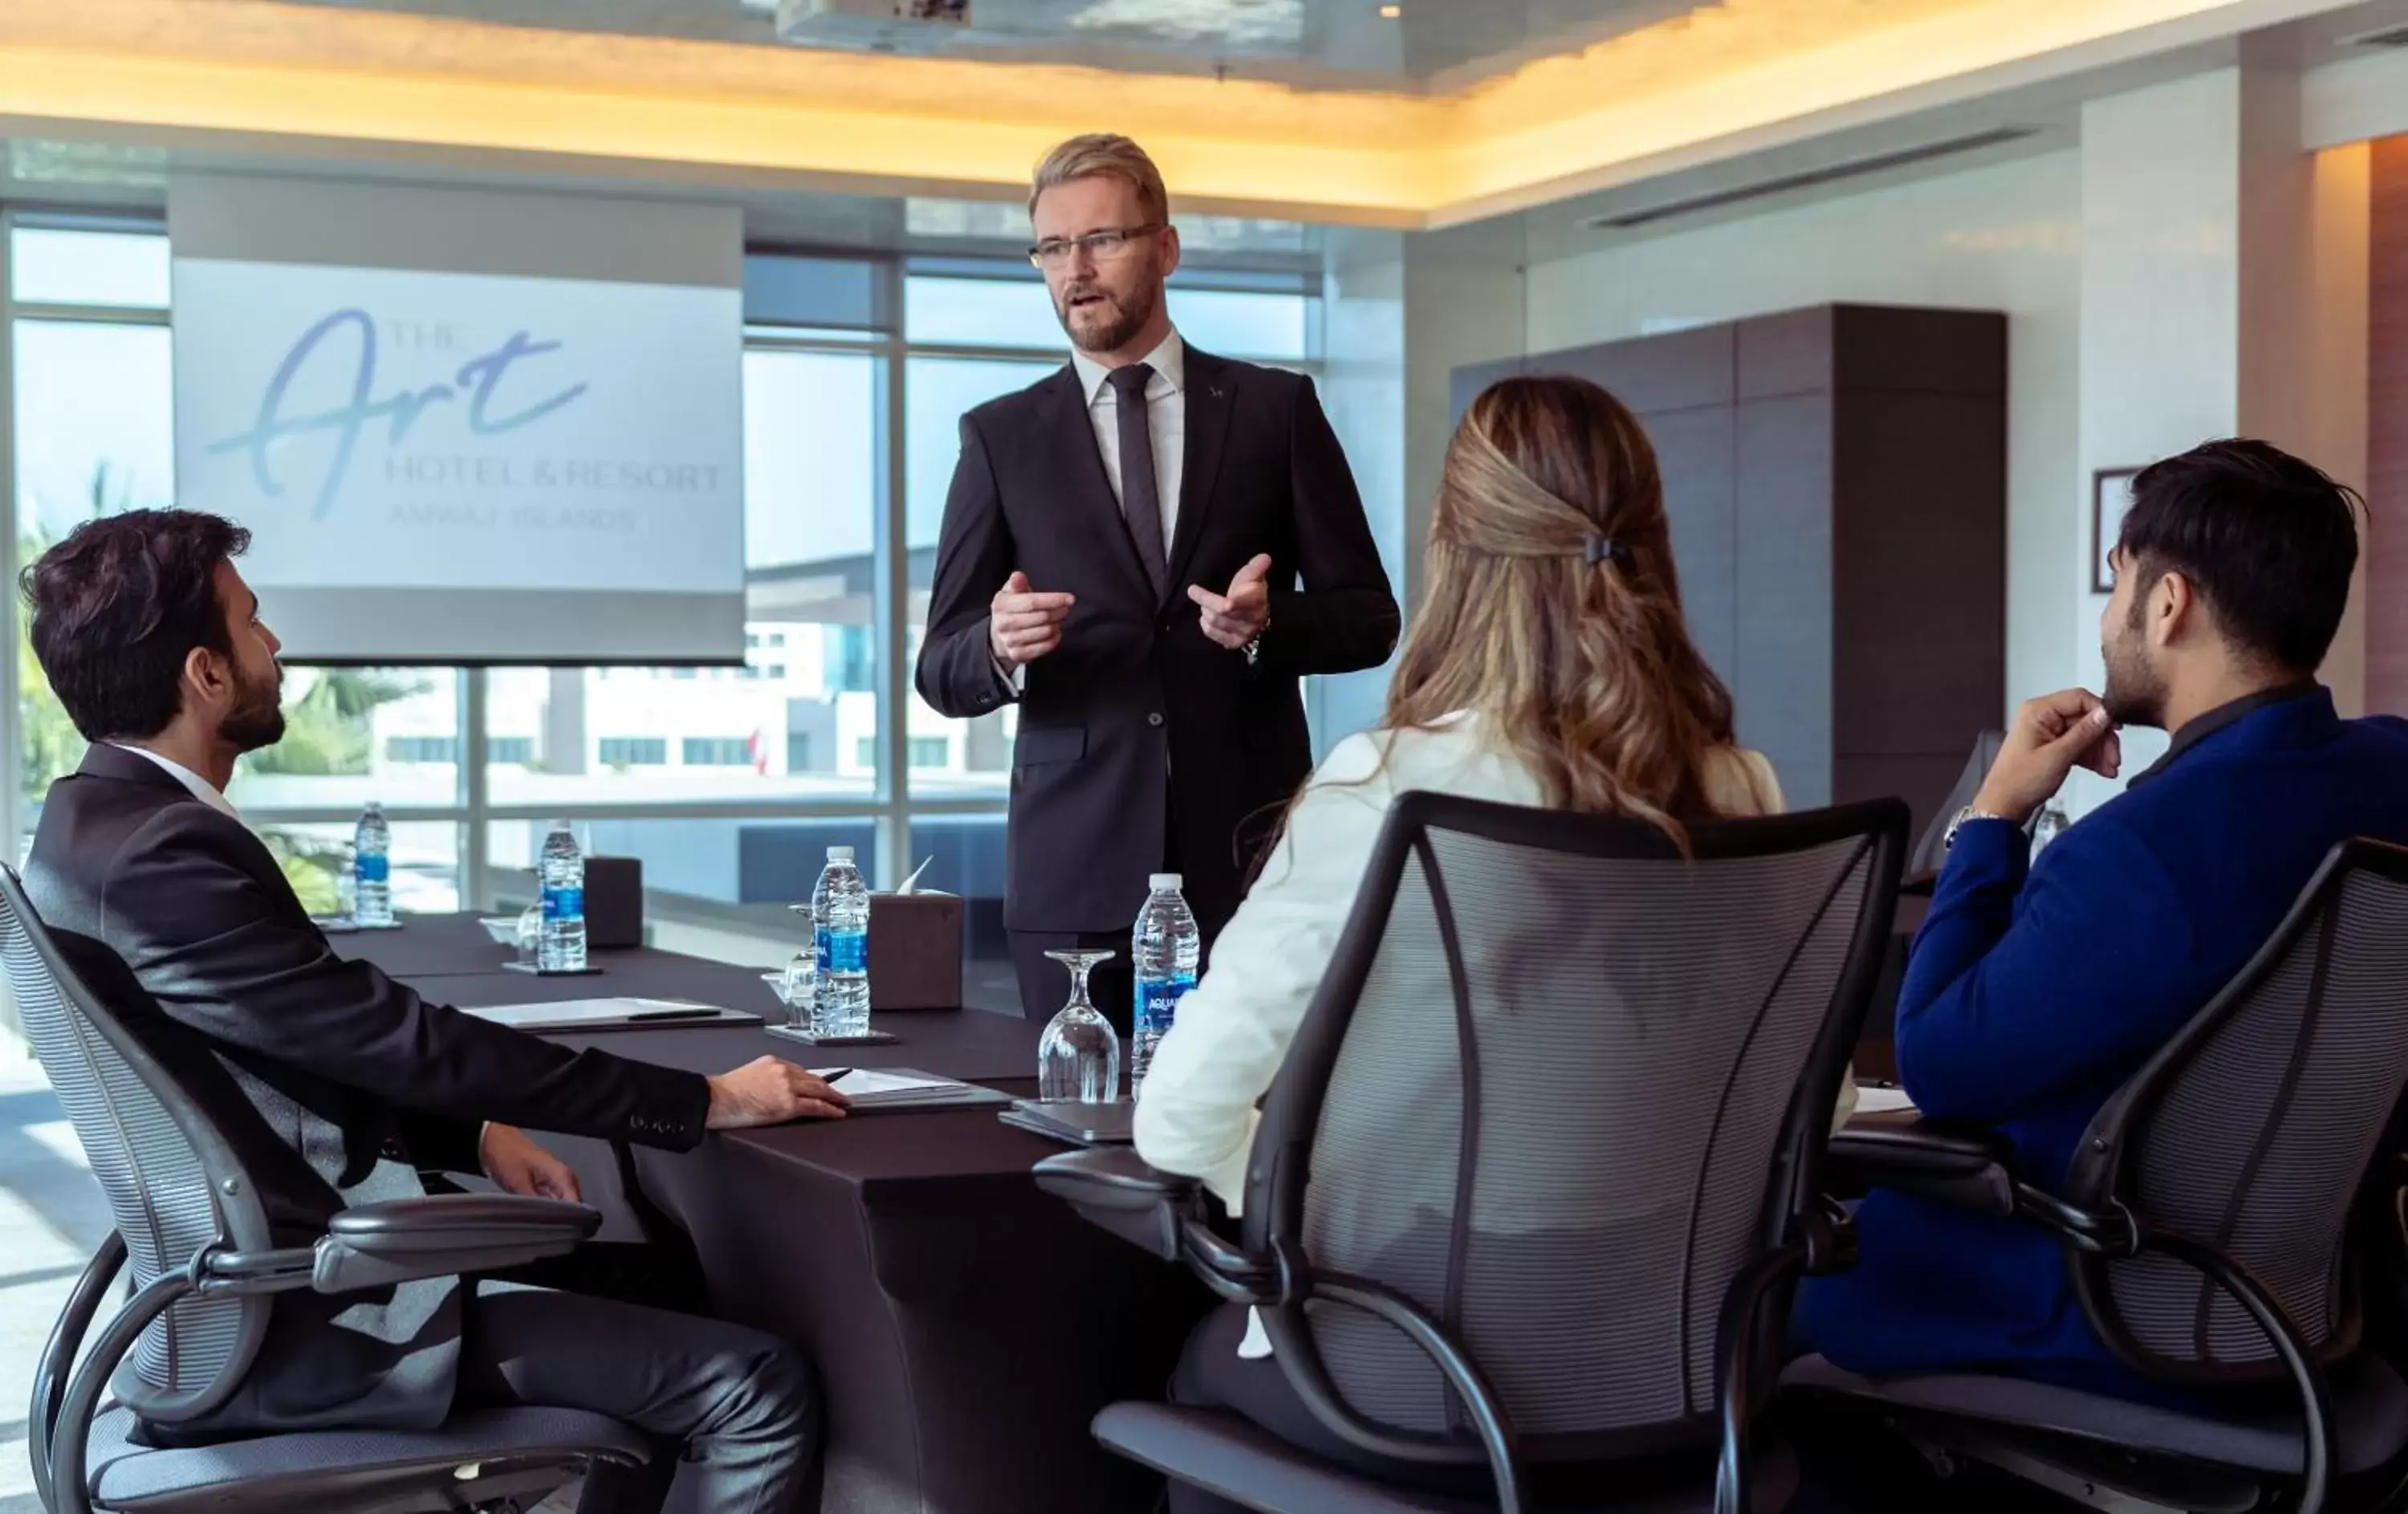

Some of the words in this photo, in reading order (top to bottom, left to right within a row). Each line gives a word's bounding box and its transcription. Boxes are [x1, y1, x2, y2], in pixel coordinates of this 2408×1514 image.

[388, 319, 469, 351] THE
[205, 307, 588, 522] Art
[385, 456, 524, 486] HOTEL
[565, 459, 720, 492] RESORT
[510, 506, 636, 531] ISLANDS
